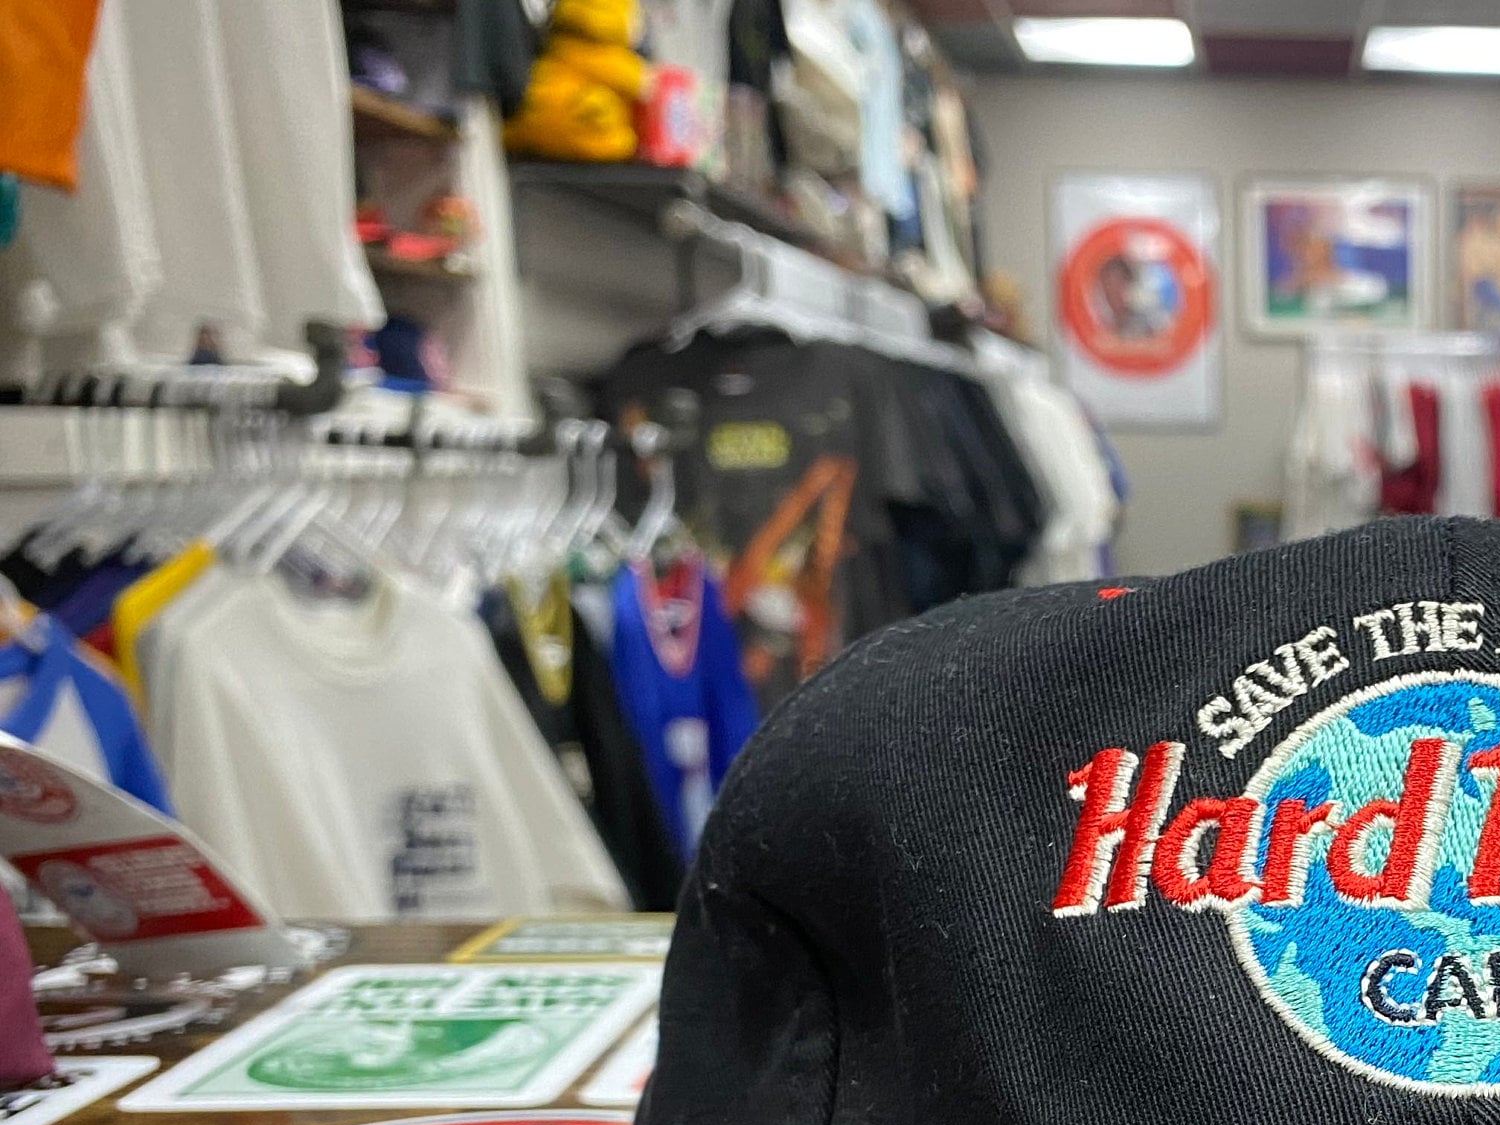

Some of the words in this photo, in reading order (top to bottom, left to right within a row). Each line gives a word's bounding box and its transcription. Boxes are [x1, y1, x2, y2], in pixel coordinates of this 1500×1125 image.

[1195, 622, 1352, 762] SAVE
[1354, 600, 1490, 660] THE
[1052, 738, 1462, 920] Hard
